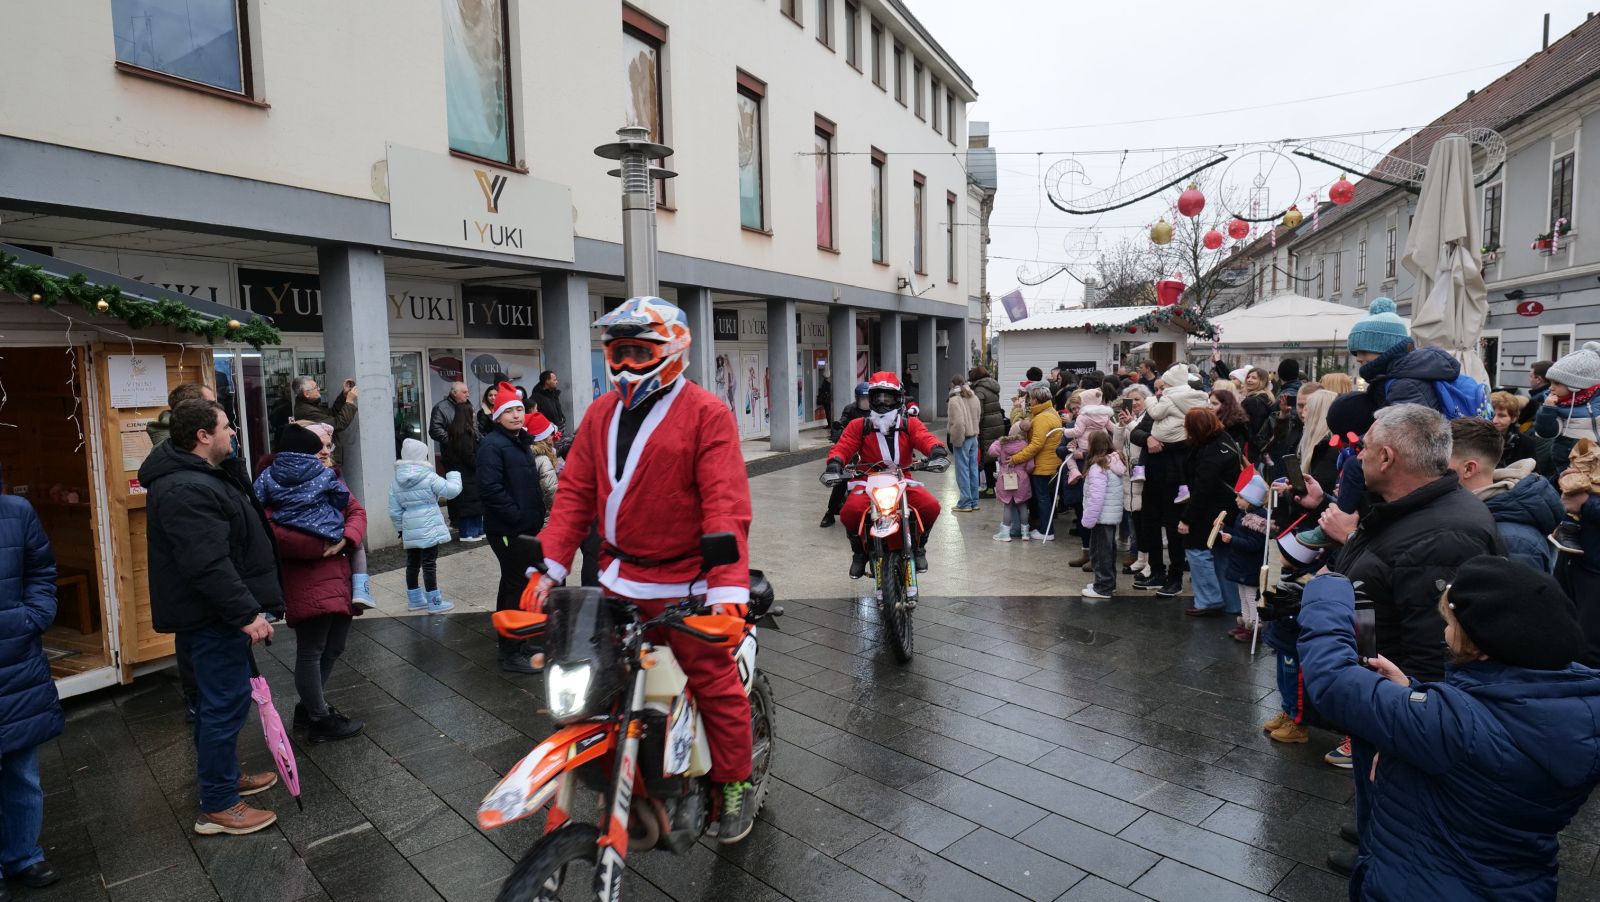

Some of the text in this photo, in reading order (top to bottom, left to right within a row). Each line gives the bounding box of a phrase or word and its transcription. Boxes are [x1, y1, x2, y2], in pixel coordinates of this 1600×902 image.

[463, 219, 524, 249] I YUKI
[389, 291, 454, 321] YUKI
[467, 300, 532, 326] I YUKI
[807, 321, 825, 337] YUKI
[479, 362, 499, 374] YUKI
